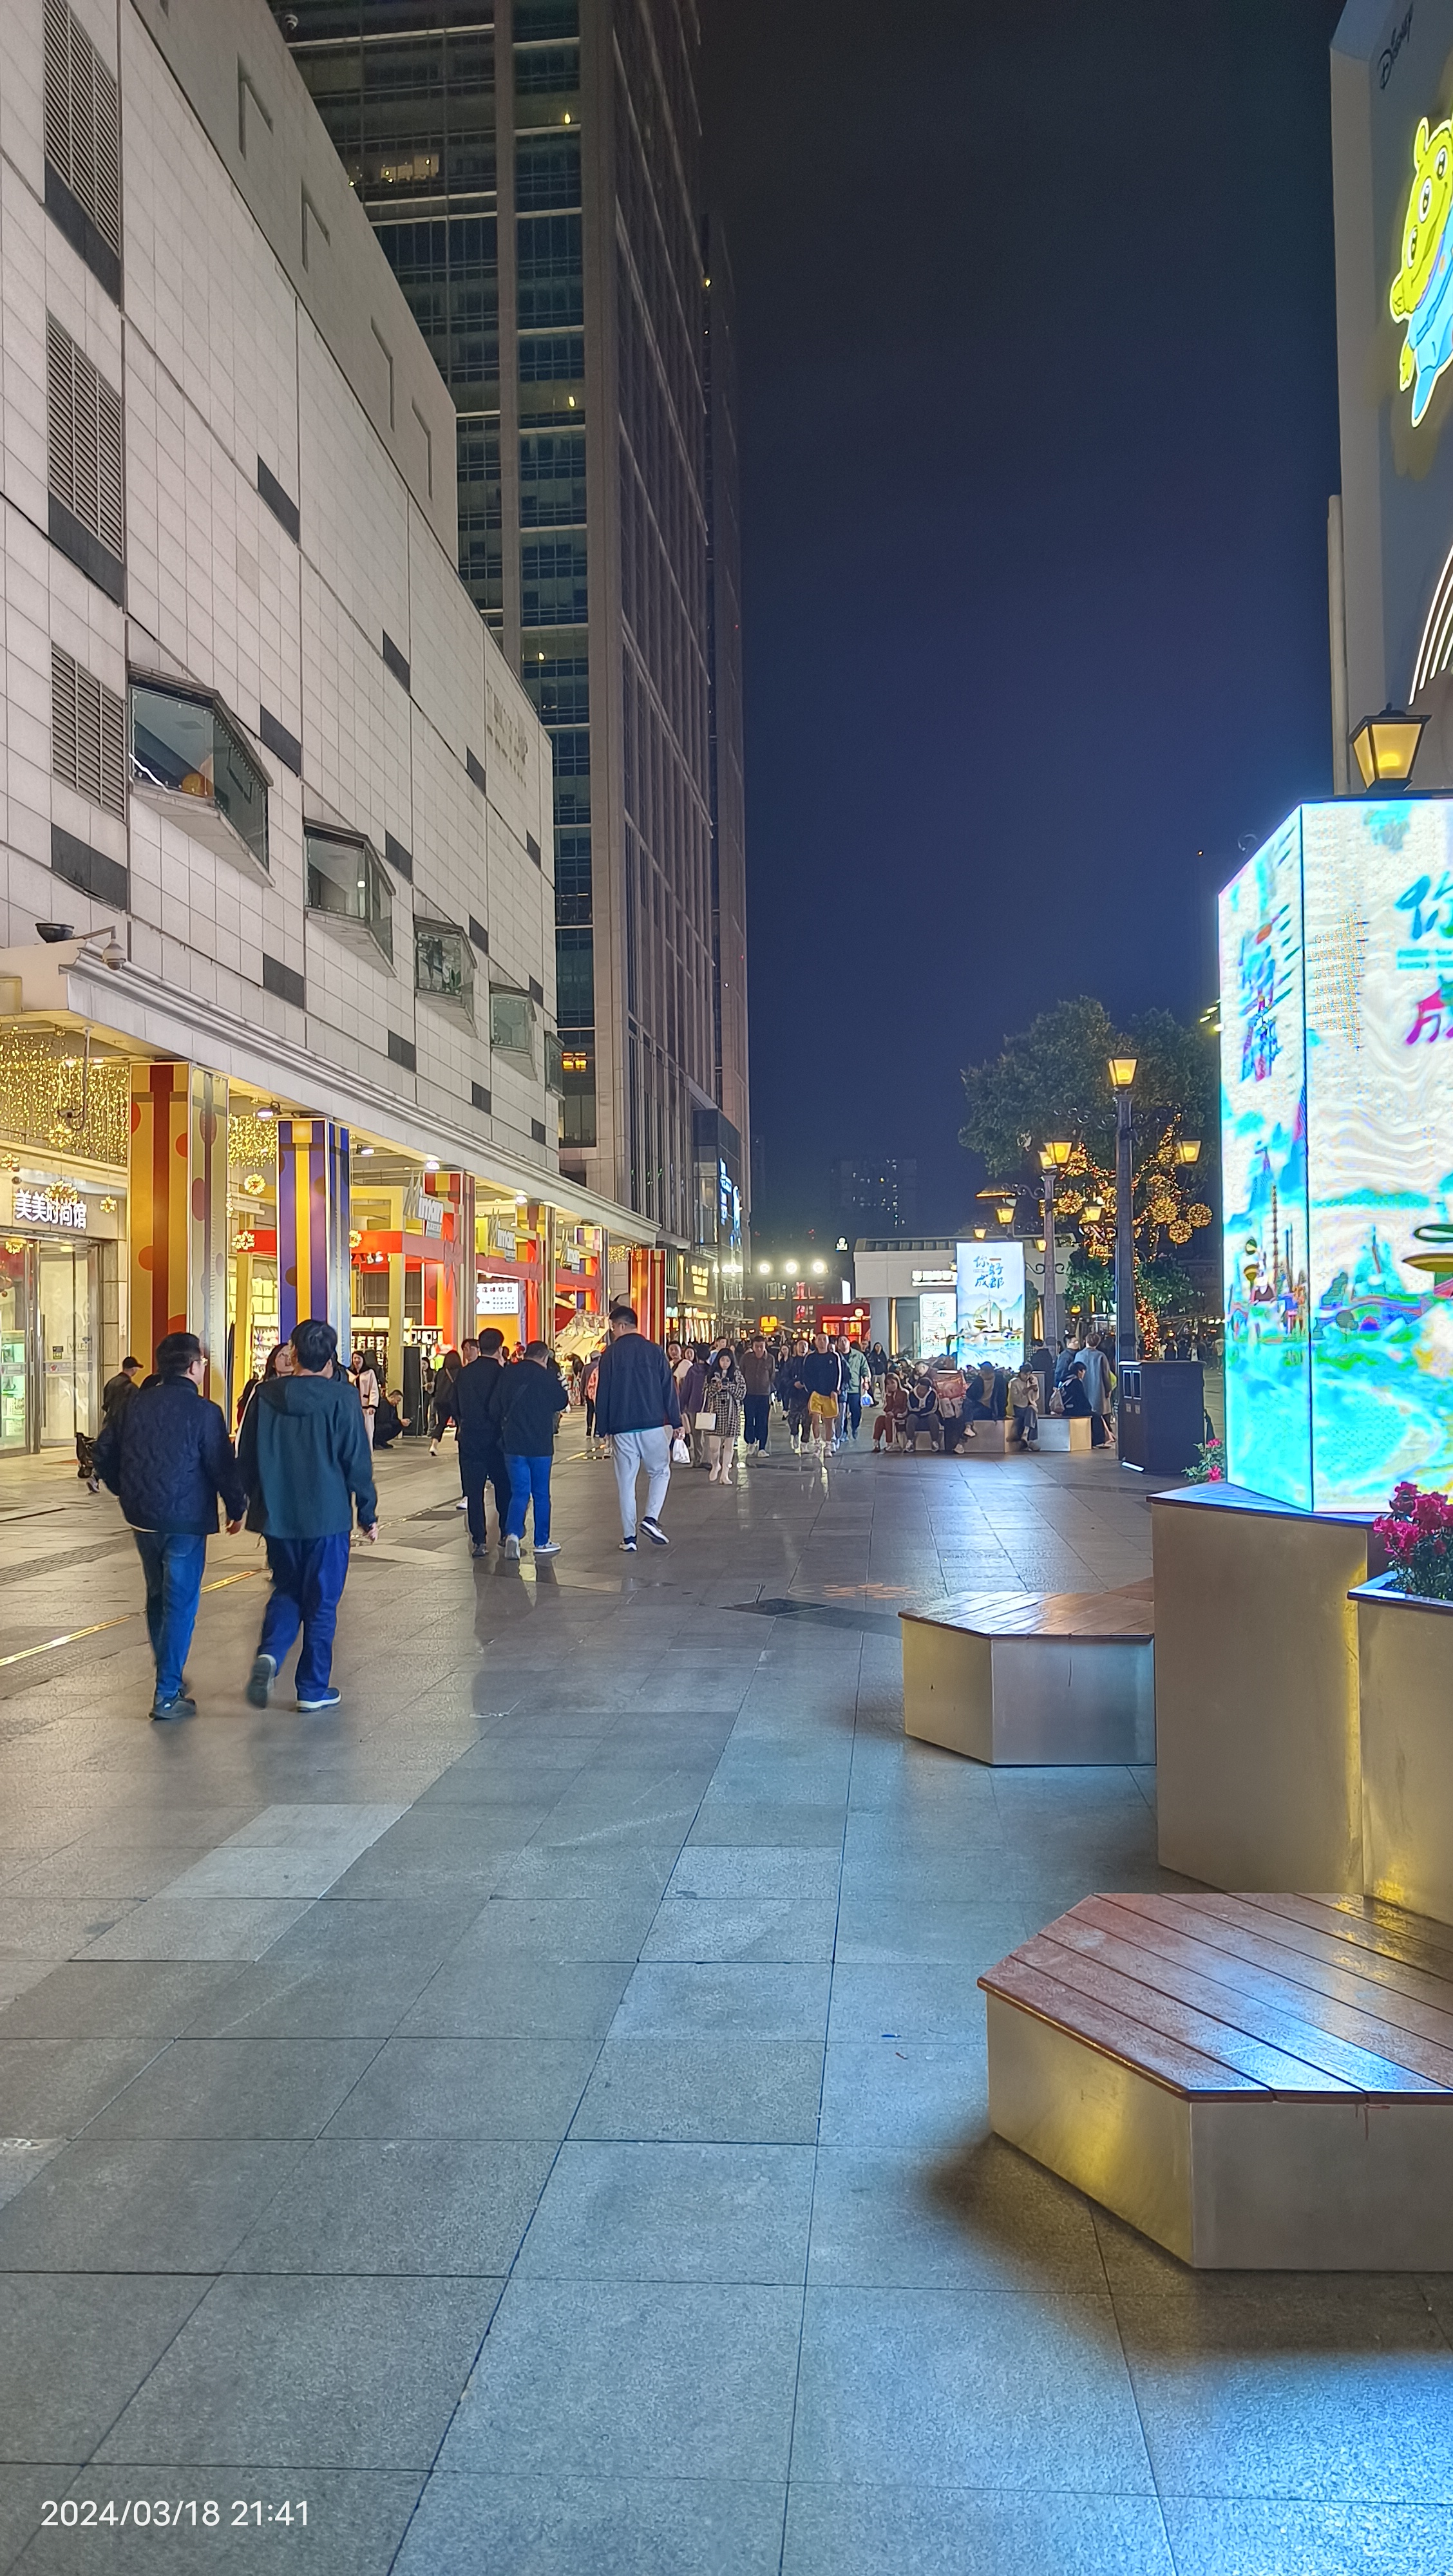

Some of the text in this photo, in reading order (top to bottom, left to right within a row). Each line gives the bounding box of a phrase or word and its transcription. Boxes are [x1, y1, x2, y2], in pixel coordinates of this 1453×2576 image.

[1377, 2, 1413, 90] Disney
[15, 1188, 87, 1229] 美美时尚馆
[973, 1255, 1003, 1275] 你好
[974, 1273, 1004, 1289] 成都
